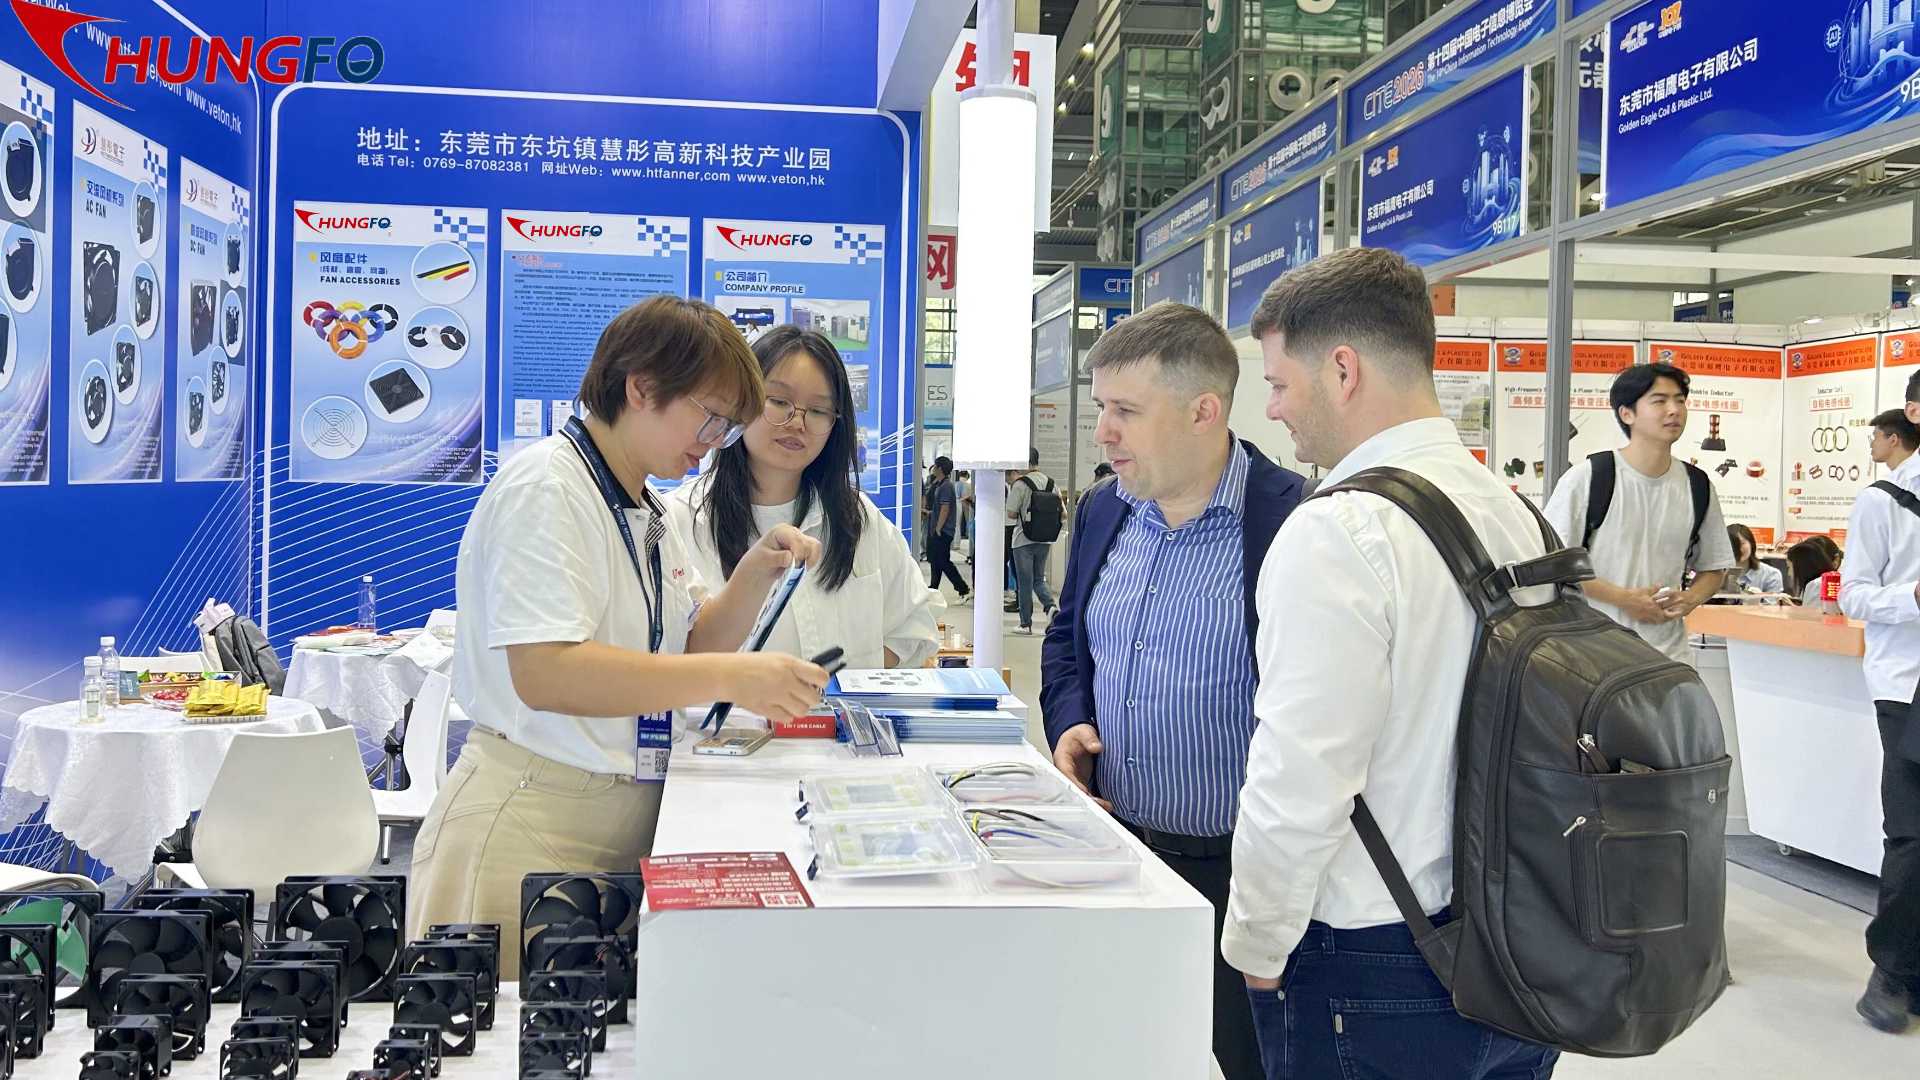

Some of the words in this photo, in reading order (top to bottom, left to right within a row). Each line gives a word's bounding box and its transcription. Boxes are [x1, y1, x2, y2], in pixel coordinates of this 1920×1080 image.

[1487, 25, 1518, 49] Technology
[1619, 38, 1758, 117] 东莞市福鹰电子有限公司
[1618, 118, 1640, 134] Golden
[1640, 112, 1658, 126] Eagle
[1658, 105, 1671, 119] Coil
[1677, 93, 1699, 112] Plastic
[439, 129, 831, 171] 东莞市东坑镇慧彤高新科技产业园
[357, 153, 384, 167] 电话
[423, 156, 529, 173] 0769-87082381
[95, 202, 108, 219] FAN
[320, 276, 338, 285] FAN
[339, 277, 400, 286] ACCESSORIES
[725, 283, 768, 293] COMPANY
[770, 284, 805, 294] PROFILE
